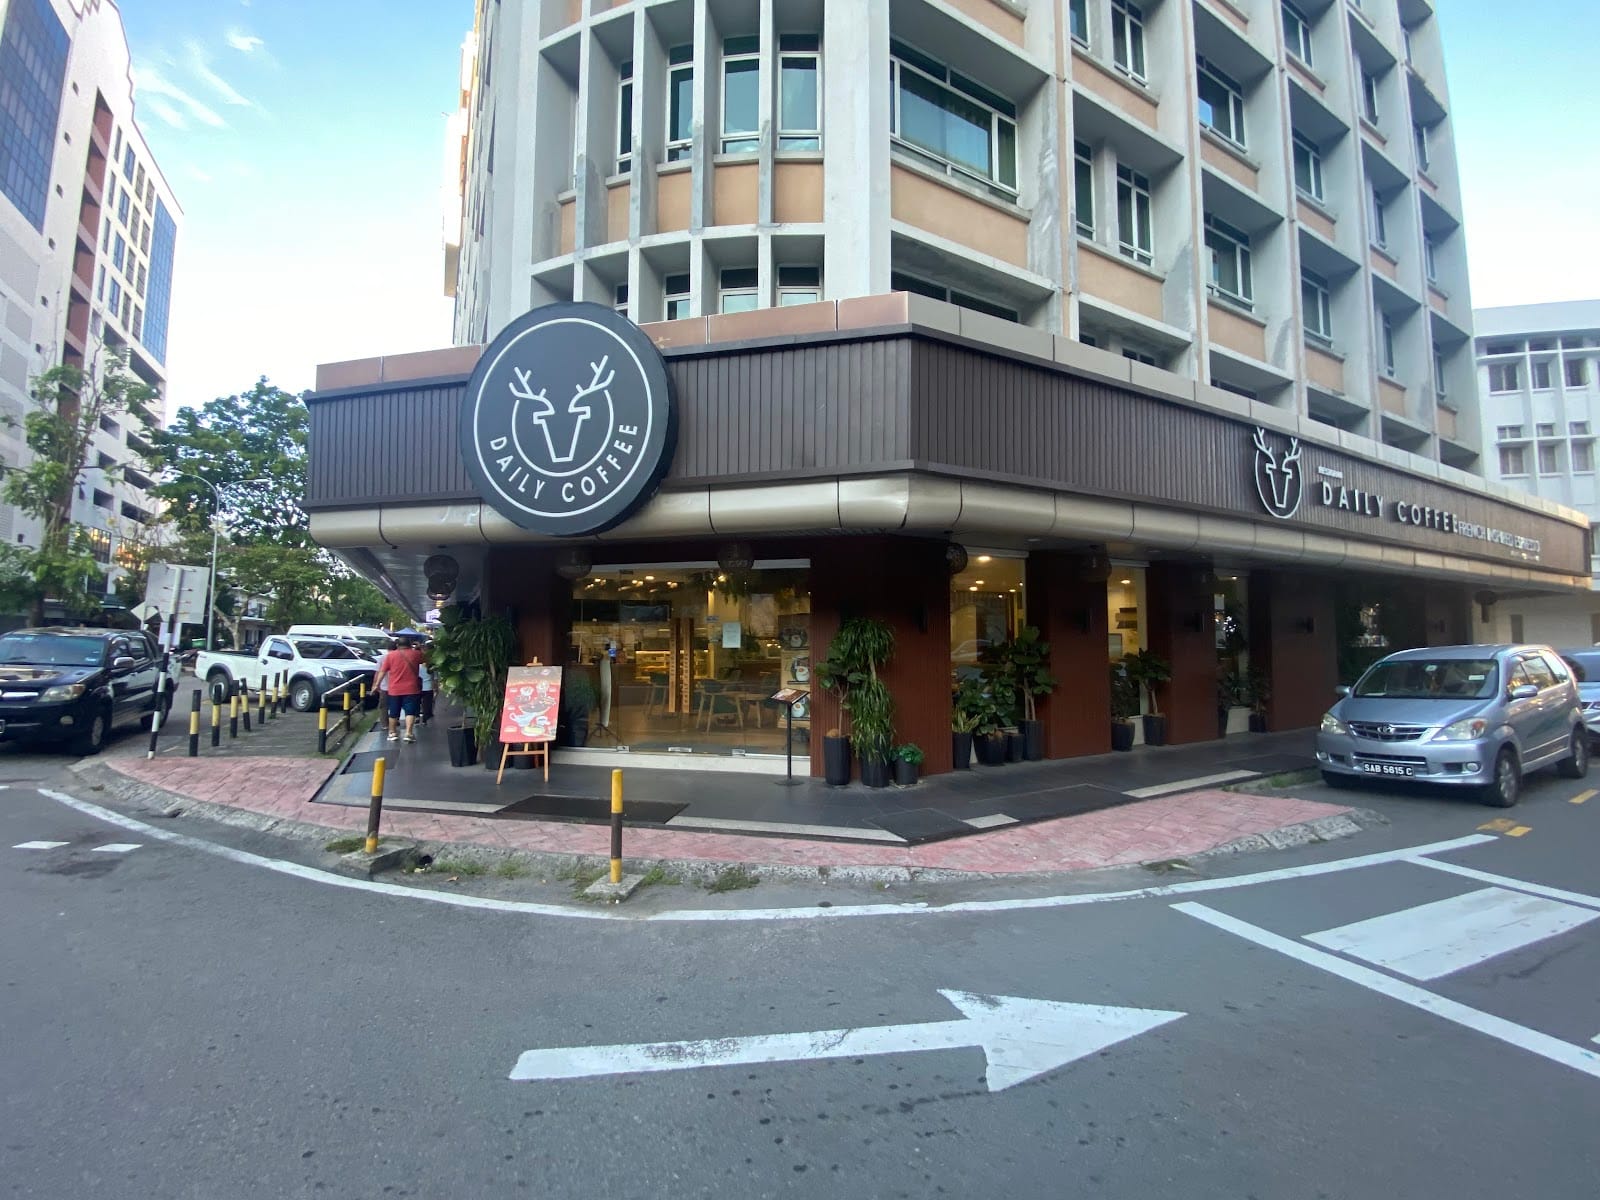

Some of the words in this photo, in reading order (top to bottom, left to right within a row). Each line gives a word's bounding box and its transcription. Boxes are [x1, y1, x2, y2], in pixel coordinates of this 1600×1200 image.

[490, 436, 546, 499] DAILY
[561, 424, 638, 503] COFFEE
[1322, 480, 1384, 517] DAILY
[1397, 500, 1459, 533] COFFEE
[1364, 763, 1382, 773] SAB
[1405, 767, 1413, 776] C
